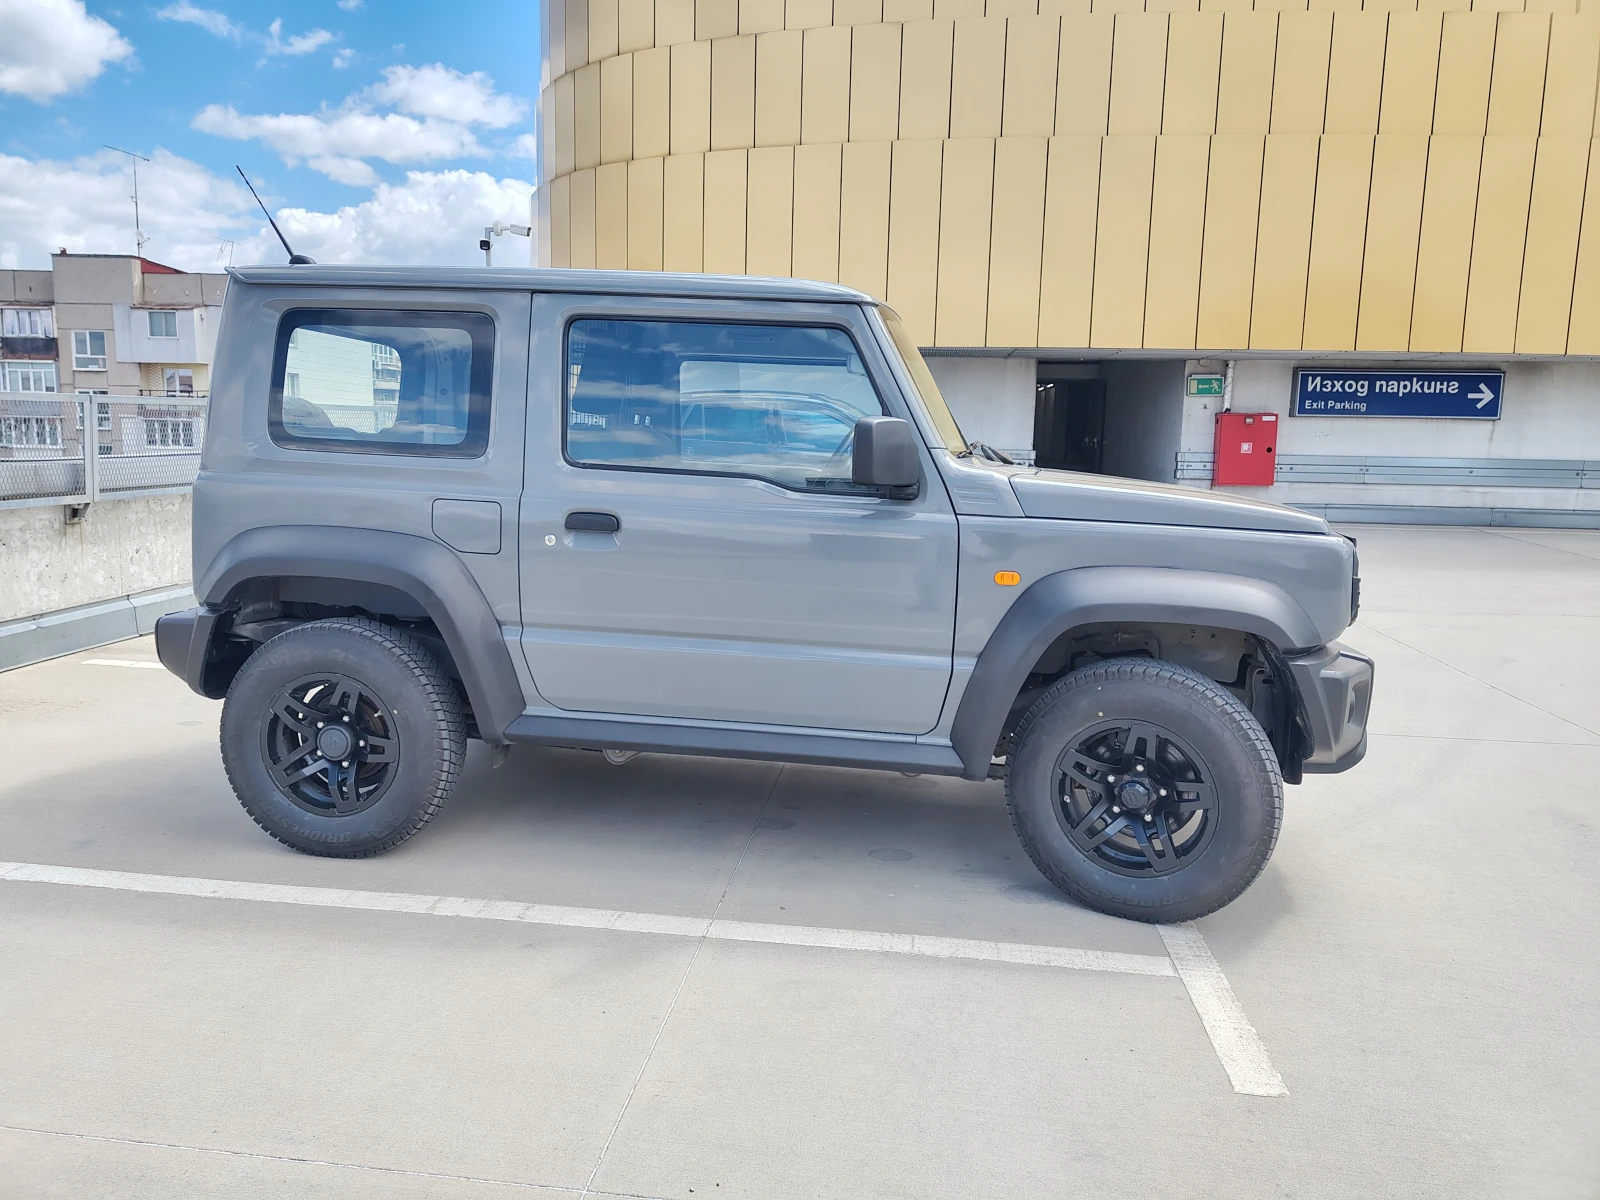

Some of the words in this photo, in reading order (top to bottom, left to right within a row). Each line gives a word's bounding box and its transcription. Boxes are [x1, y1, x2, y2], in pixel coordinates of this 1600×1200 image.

[1307, 376, 1368, 396] Изход
[1375, 377, 1459, 397] паркинг
[1305, 400, 1325, 409] Exit
[1327, 401, 1367, 411] Parking
[250, 791, 352, 843] BRIDGESTON
